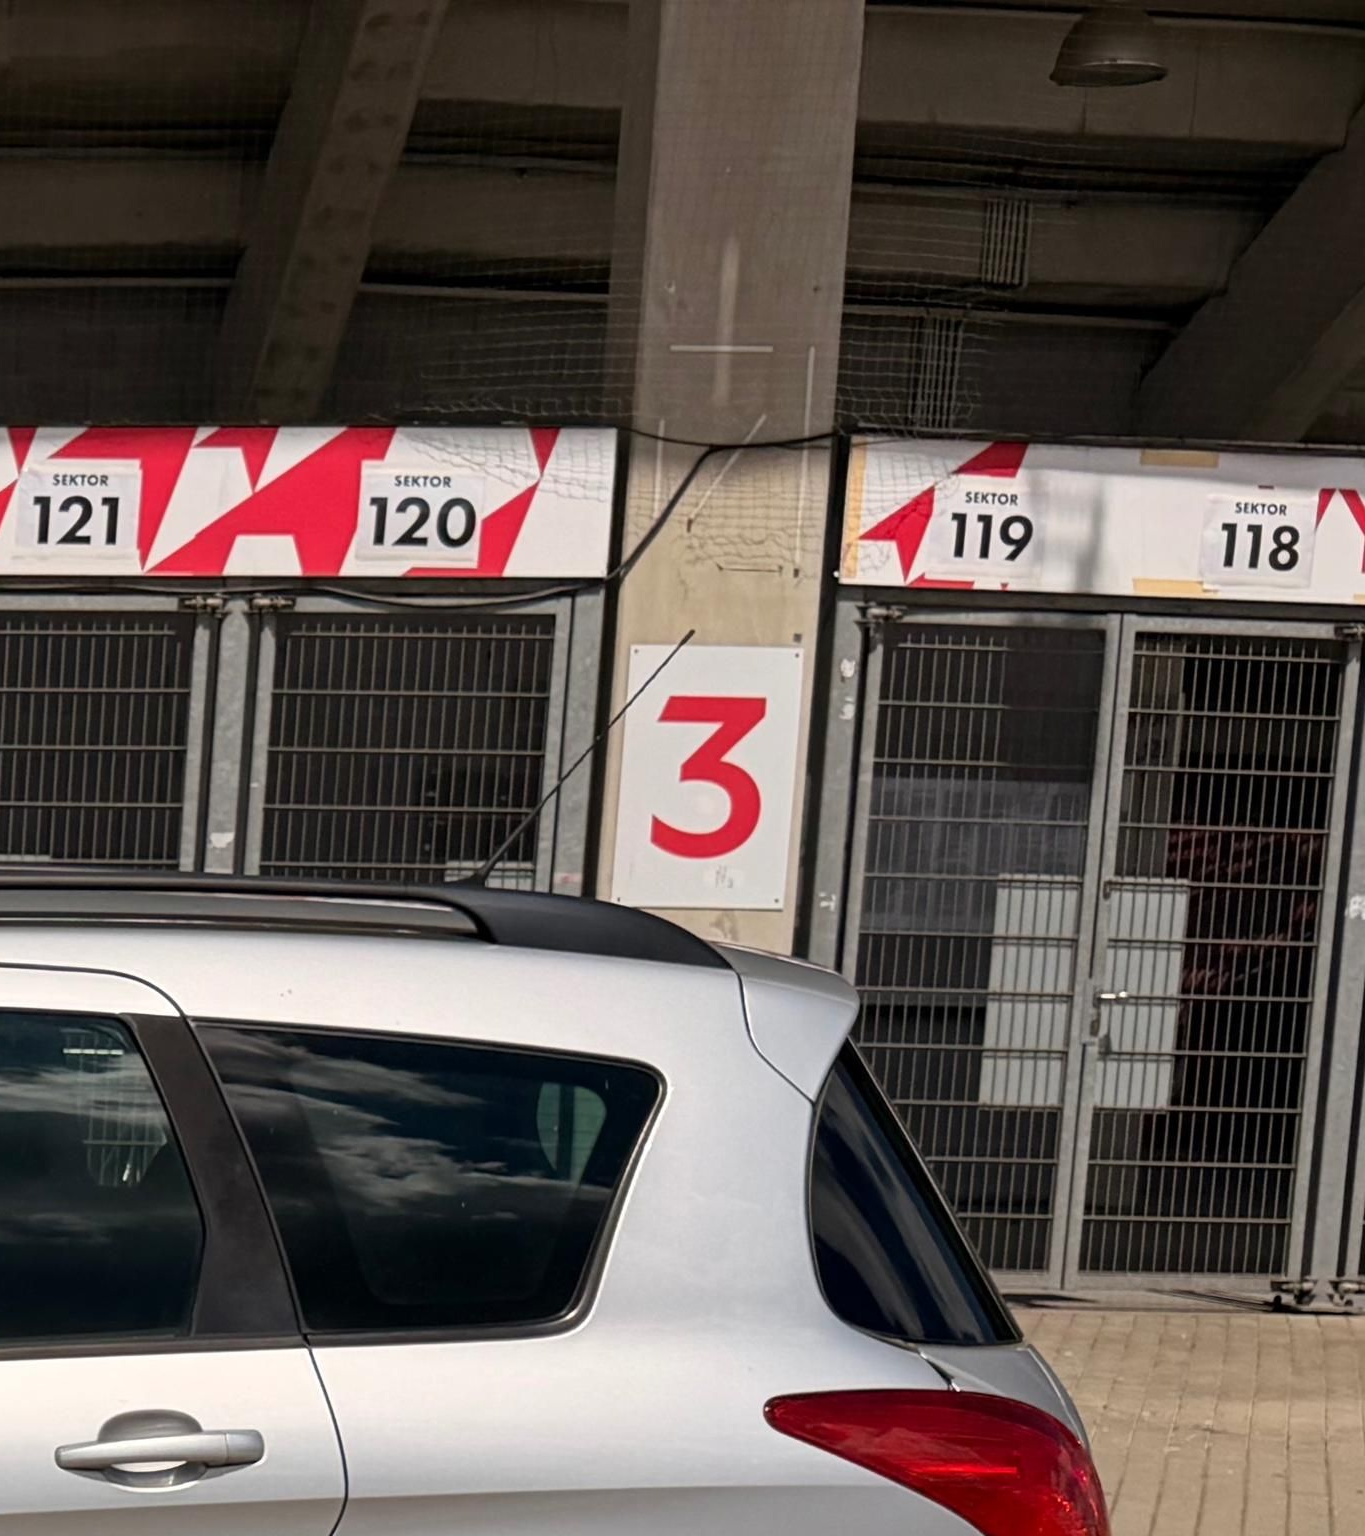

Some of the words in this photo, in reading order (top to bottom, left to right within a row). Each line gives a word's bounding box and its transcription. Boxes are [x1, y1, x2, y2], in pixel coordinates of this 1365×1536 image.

[52, 474, 109, 486] SEKTOR
[394, 475, 452, 488] SEKTOR
[964, 491, 1019, 506] SEKTOR
[33, 495, 120, 545] 121
[369, 496, 477, 548] 120
[1234, 502, 1288, 516] SEKTOR
[951, 512, 1034, 561] 119
[1221, 522, 1300, 571] 118
[650, 696, 767, 859] 3
